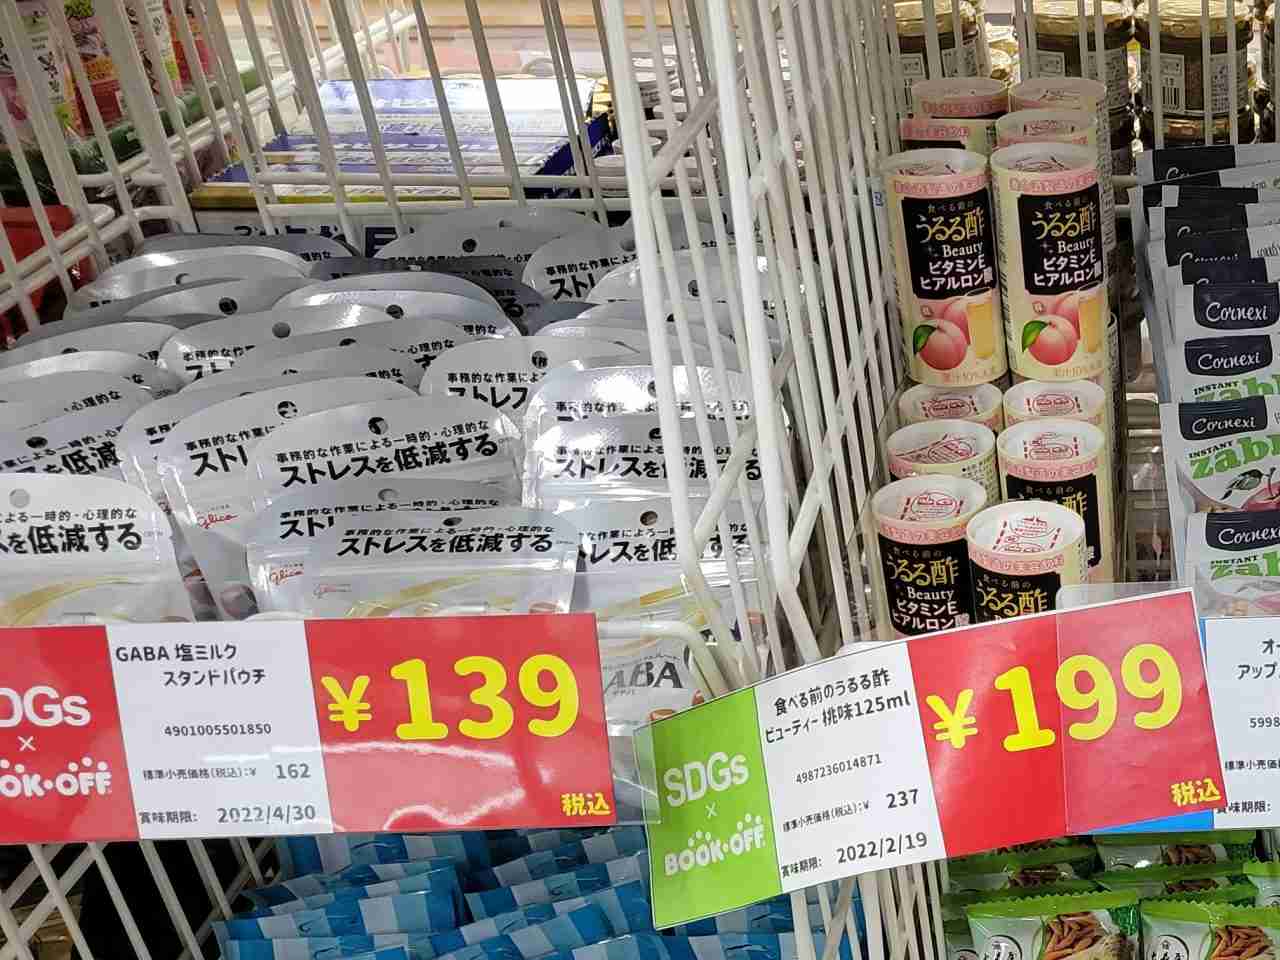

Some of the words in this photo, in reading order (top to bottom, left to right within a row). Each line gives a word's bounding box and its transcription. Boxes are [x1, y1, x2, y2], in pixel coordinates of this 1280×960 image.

[942, 241, 984, 258] Beauty
[1057, 237, 1096, 254] Beauty
[1206, 302, 1269, 322] Cornexi
[1197, 351, 1262, 371] Cornexi
[1191, 416, 1257, 434] Cornexi
[280, 433, 499, 488] ストレスを低減する
[337, 534, 554, 557] ストレスを低減する
[907, 586, 954, 601] Beauty
[115, 645, 170, 662] GABA
[175, 643, 238, 661] 塩ミルク
[163, 668, 267, 687] スタンドパウチ
[774, 667, 891, 717] 食べる前のうるる酢
[0, 685, 92, 728] DGs
[164, 723, 272, 738] 4901005501850
[276, 762, 312, 780] 162
[795, 753, 882, 784] 4987236014871
[663, 752, 749, 807] SDGs
[886, 789, 919, 810] 237
[1171, 778, 1221, 807] 税込
[216, 804, 317, 825] 2022/4/30
[560, 791, 612, 817] 税込
[837, 831, 928, 865] 2022/2/19
